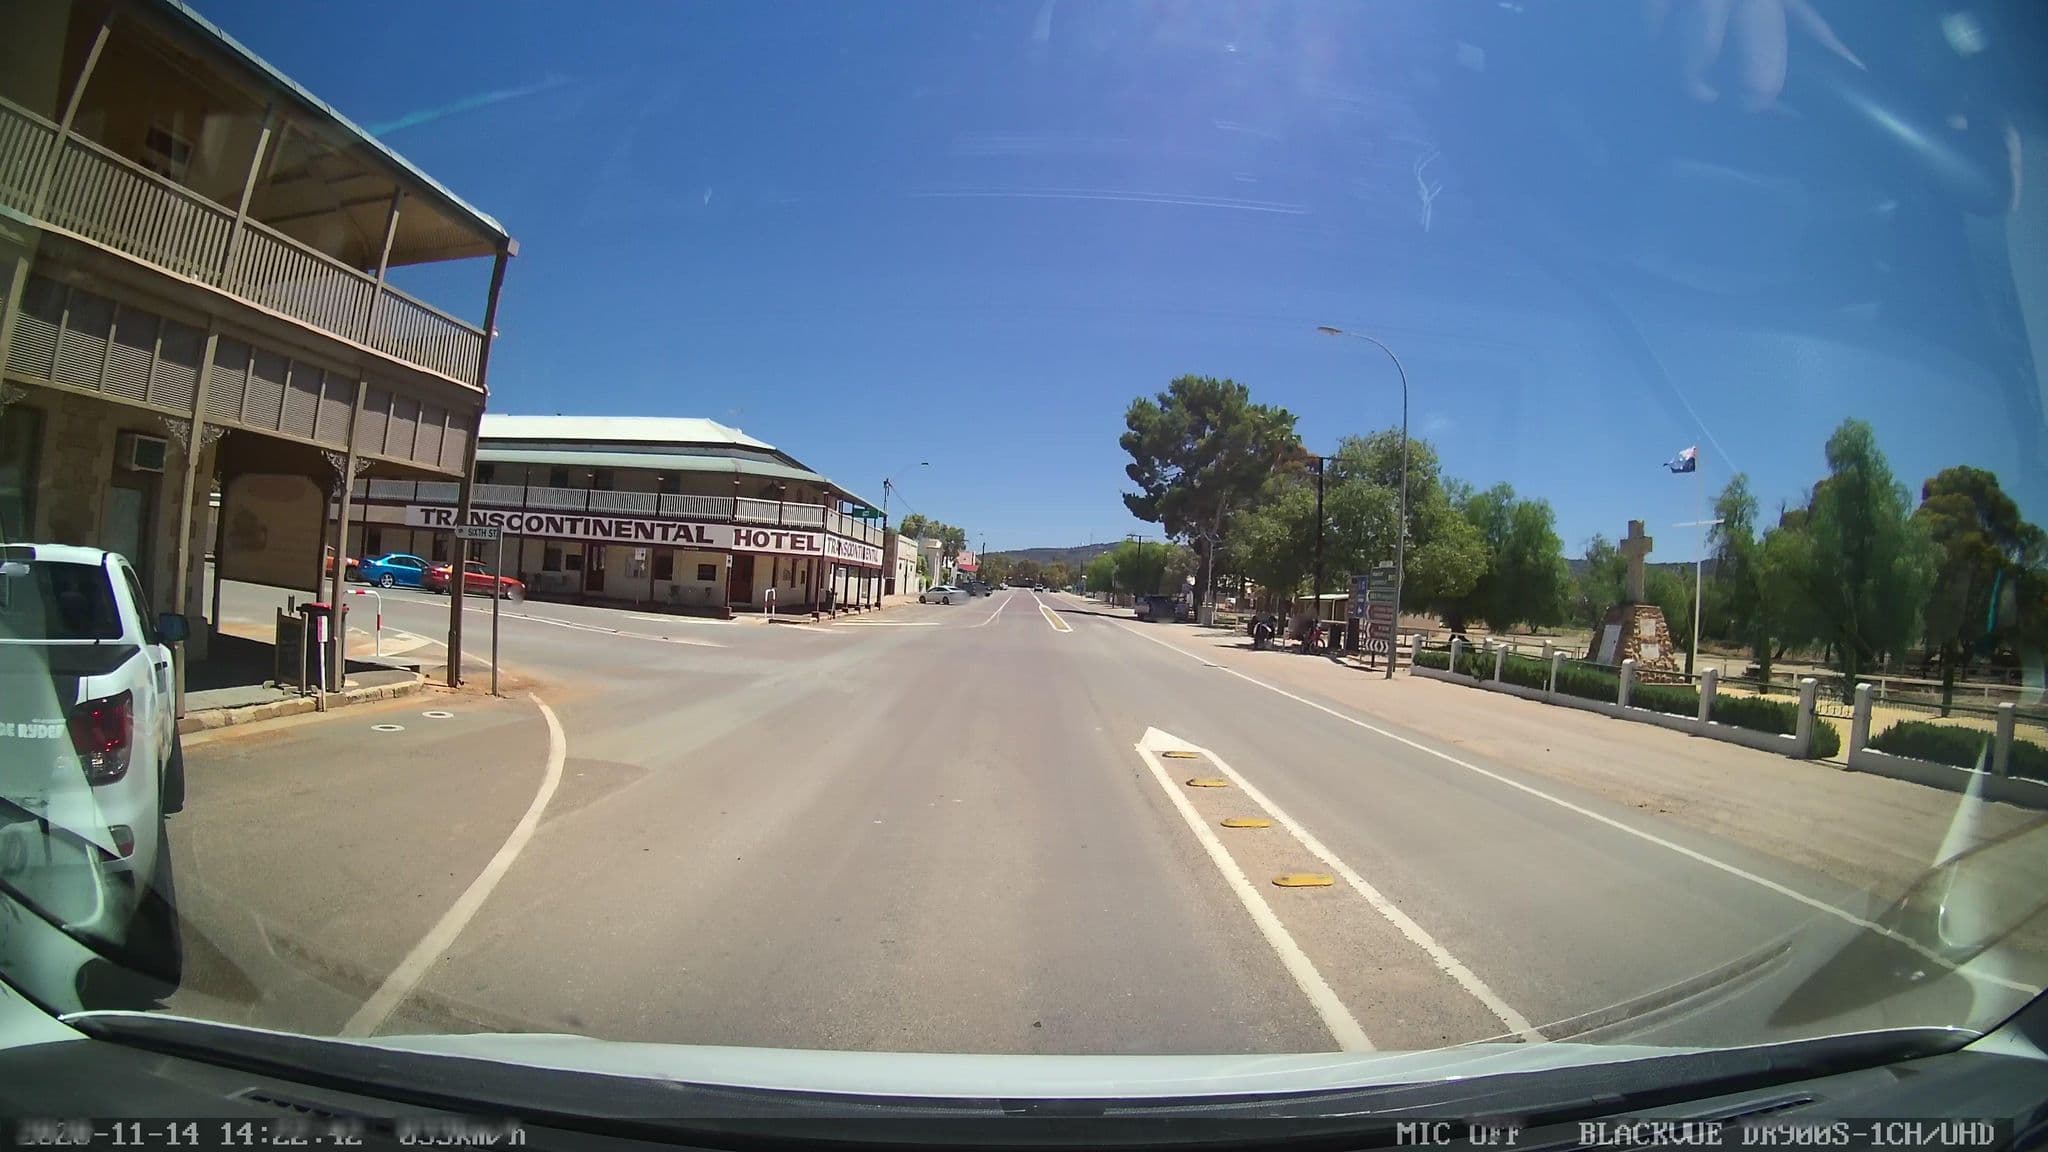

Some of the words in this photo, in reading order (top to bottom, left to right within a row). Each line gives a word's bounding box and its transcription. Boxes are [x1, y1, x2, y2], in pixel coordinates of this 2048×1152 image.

[468, 528, 487, 538] SIXTH
[488, 528, 497, 538] ST
[734, 529, 821, 552] HOTEL
[827, 537, 879, 562] TRNSCONTIENTAL
